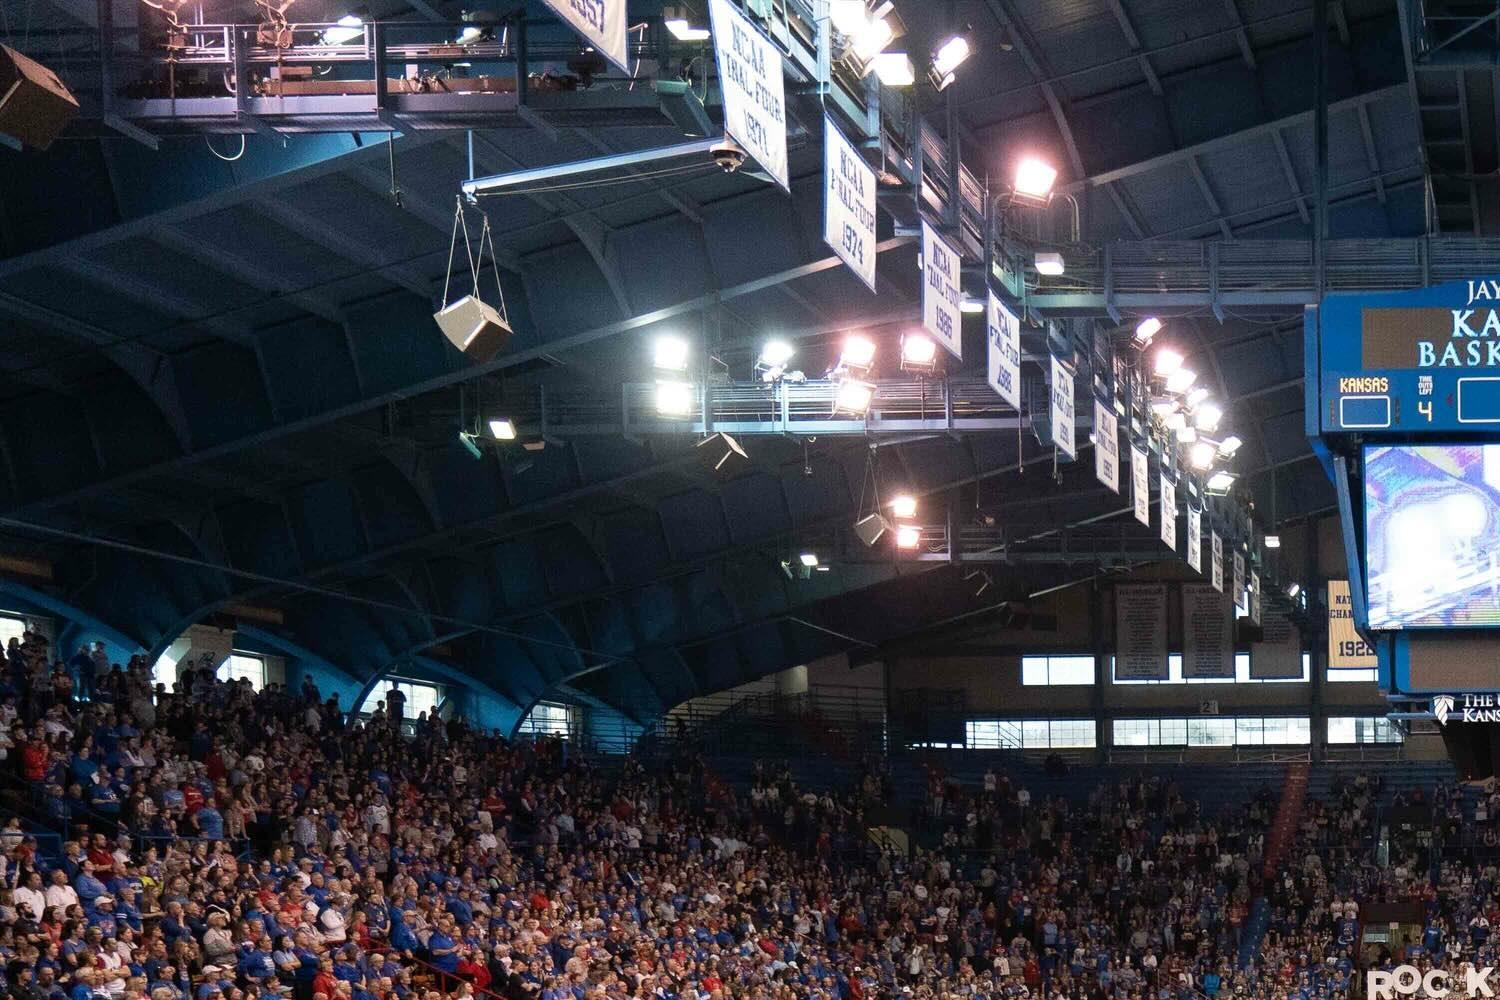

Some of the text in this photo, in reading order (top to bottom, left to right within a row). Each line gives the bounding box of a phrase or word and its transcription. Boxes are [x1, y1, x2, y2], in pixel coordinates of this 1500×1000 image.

[570, 0, 605, 34] 957
[731, 20, 767, 80] NCAA
[723, 50, 753, 104] INAL
[840, 147, 865, 199] NCAA
[841, 220, 864, 265] 1974
[932, 240, 952, 280] NCAA
[1340, 377, 1389, 393] KANSAS
[1418, 401, 1432, 422] 4
[1462, 694, 1493, 707] THE
